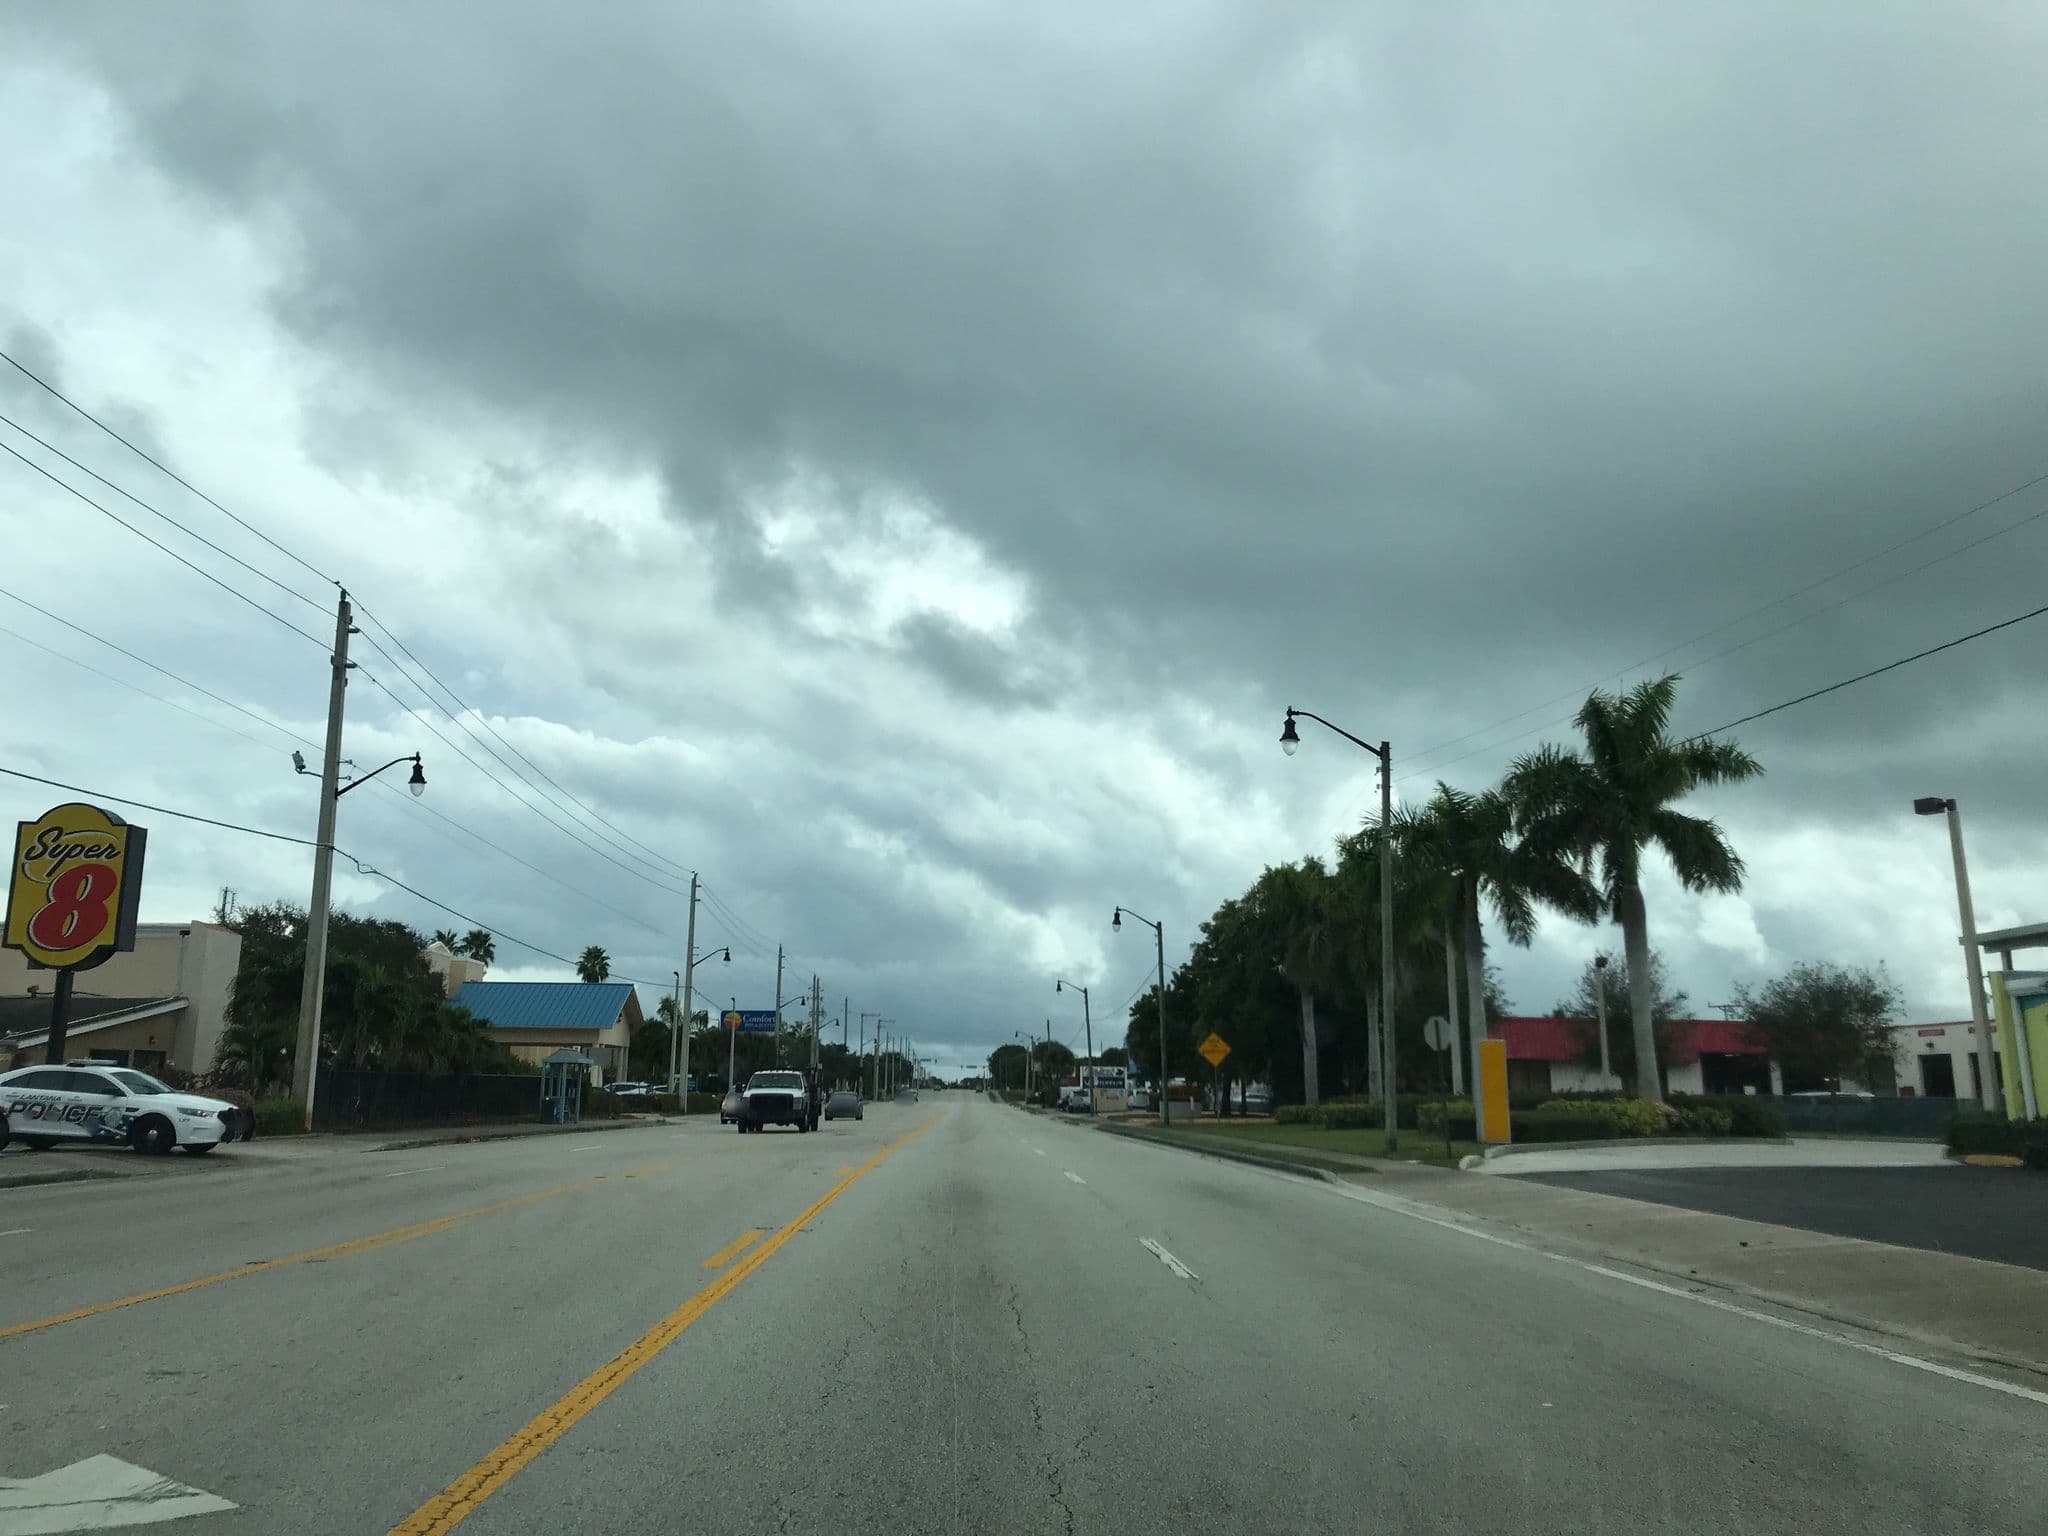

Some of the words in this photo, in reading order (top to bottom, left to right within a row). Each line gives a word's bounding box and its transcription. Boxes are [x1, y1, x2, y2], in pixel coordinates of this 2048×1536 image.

[24, 826, 121, 877] Super
[28, 863, 118, 952] 8
[742, 1014, 776, 1023] Comfort
